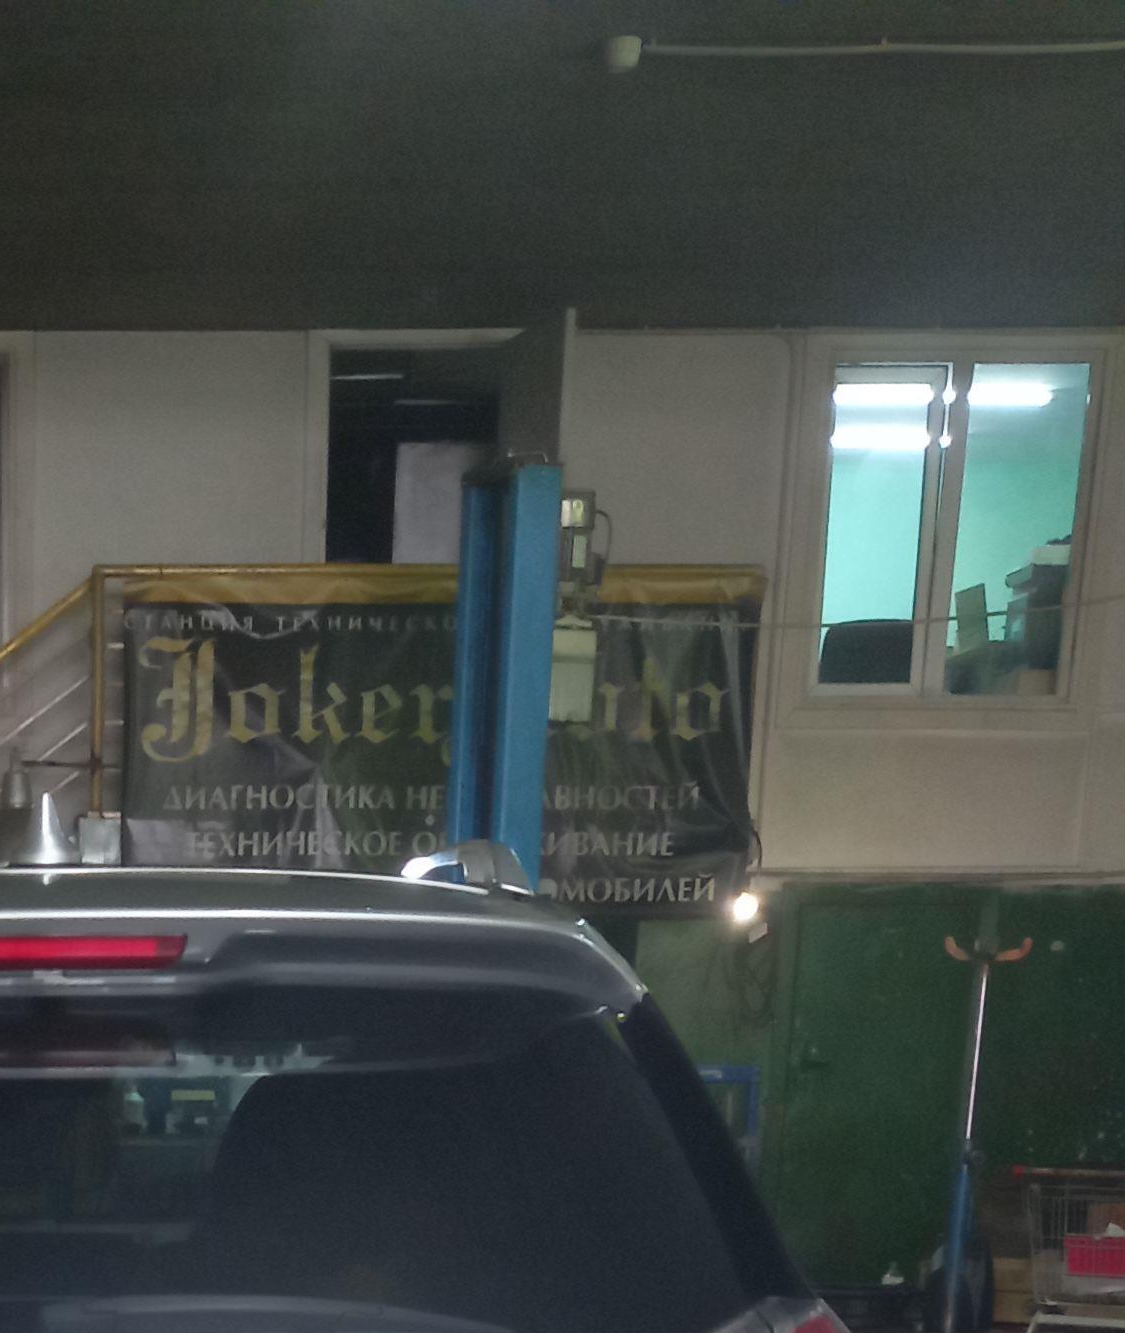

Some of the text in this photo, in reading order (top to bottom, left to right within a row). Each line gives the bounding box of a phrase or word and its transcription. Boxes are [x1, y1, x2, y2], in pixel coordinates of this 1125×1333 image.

[138, 636, 454, 763] Joker
[163, 782, 395, 811] ДИАГНОСТИКА
[187, 829, 402, 857] ТЕХНИЧЕСКОЕ
